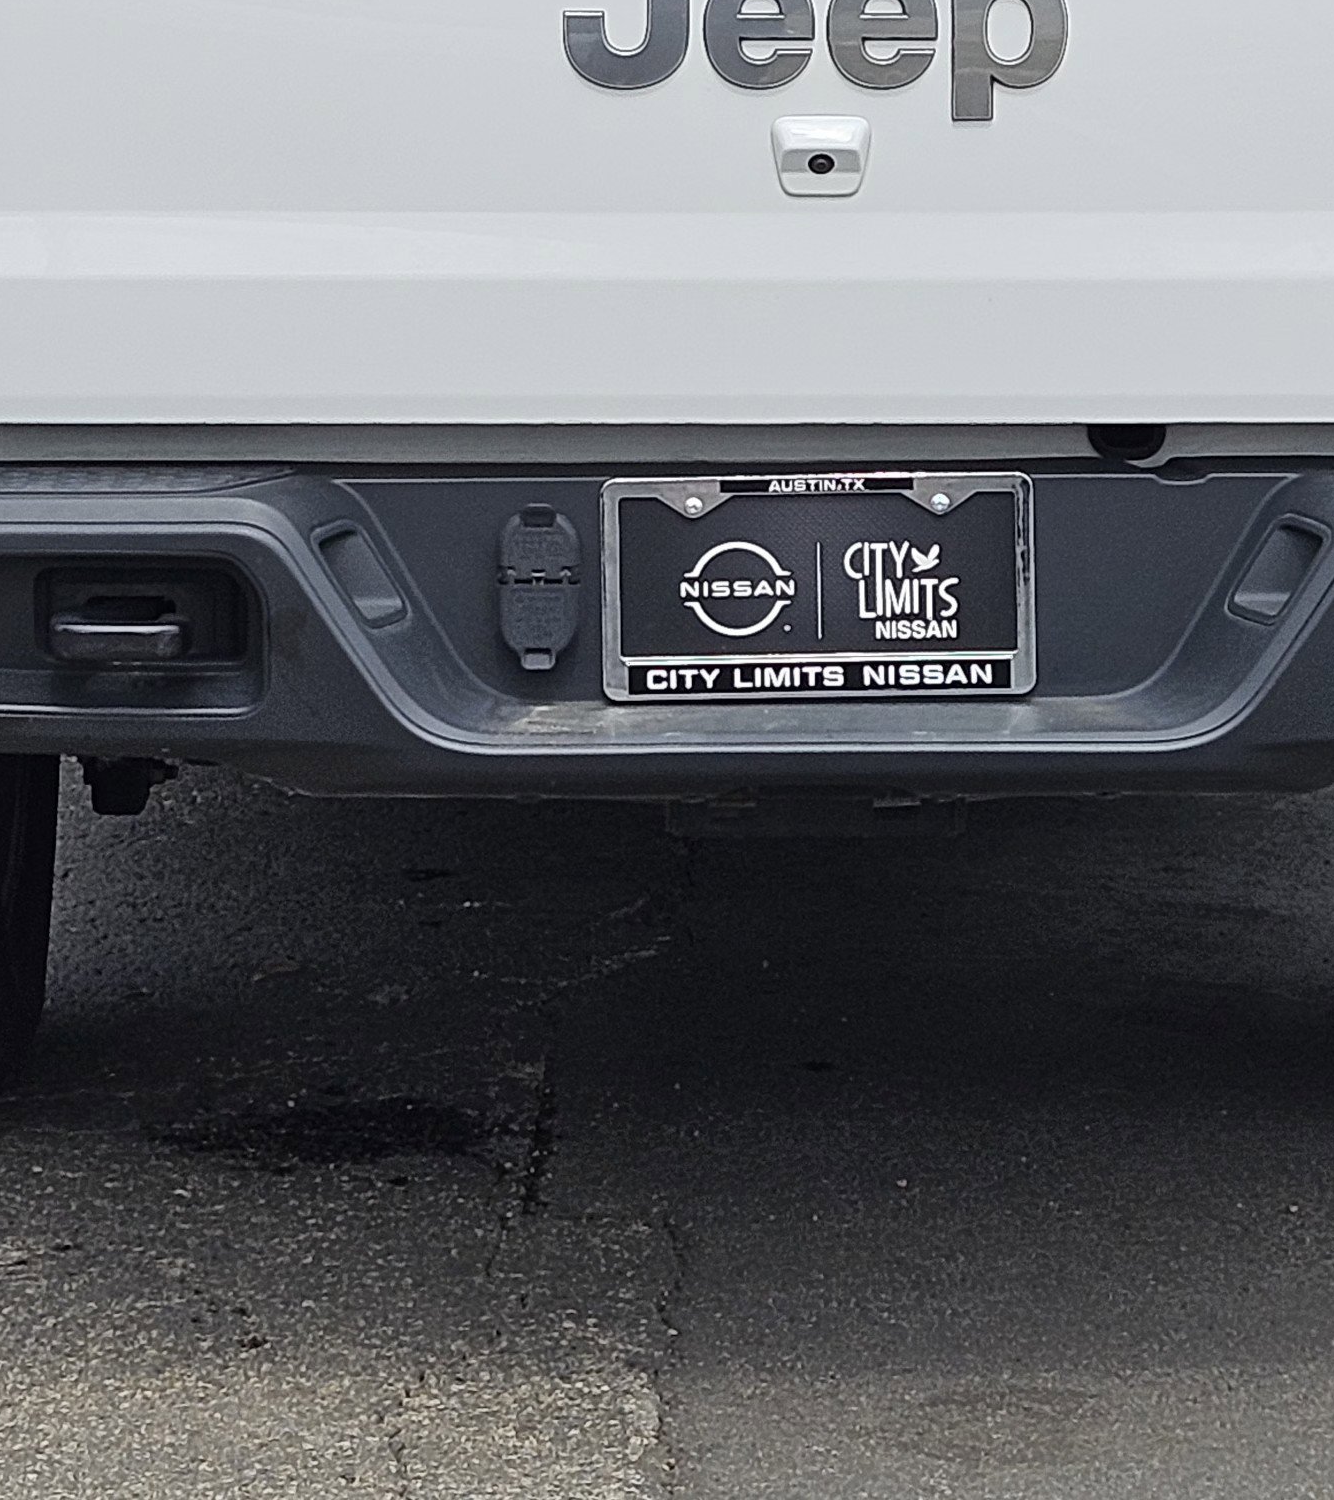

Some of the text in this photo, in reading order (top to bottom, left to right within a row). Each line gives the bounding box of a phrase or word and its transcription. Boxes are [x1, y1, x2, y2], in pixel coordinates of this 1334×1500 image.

[843, 540, 911, 580] CITY
[679, 579, 795, 598] NISSAN
[859, 576, 960, 620] LIMITS
[875, 619, 958, 639] NISSAN
[645, 663, 993, 690] CITY LIMITS NISSAN
